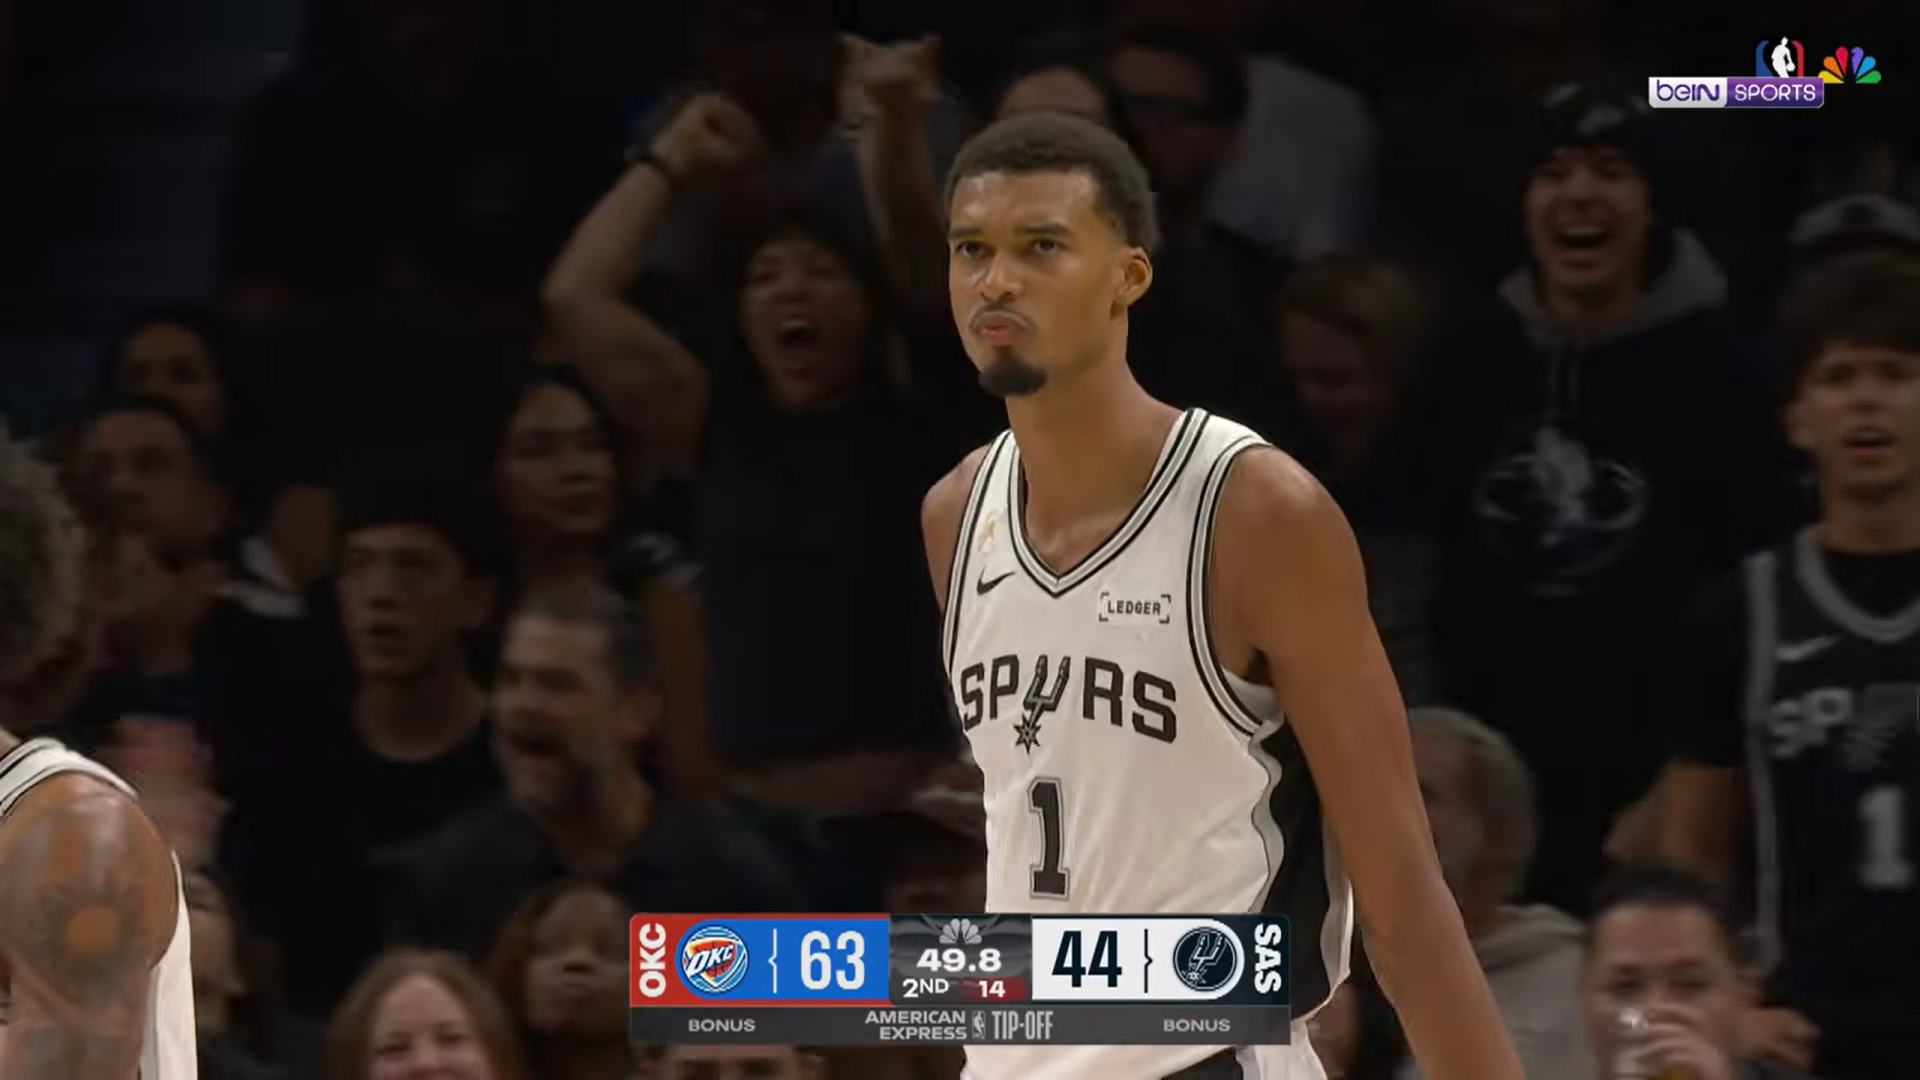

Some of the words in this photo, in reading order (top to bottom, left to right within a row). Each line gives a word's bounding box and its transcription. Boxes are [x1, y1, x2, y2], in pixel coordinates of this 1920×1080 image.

[1107, 600, 1161, 615] LEDGER
[960, 654, 1177, 754] SPURS
[1027, 776, 1069, 901] 1
[1858, 786, 1915, 889] 1
